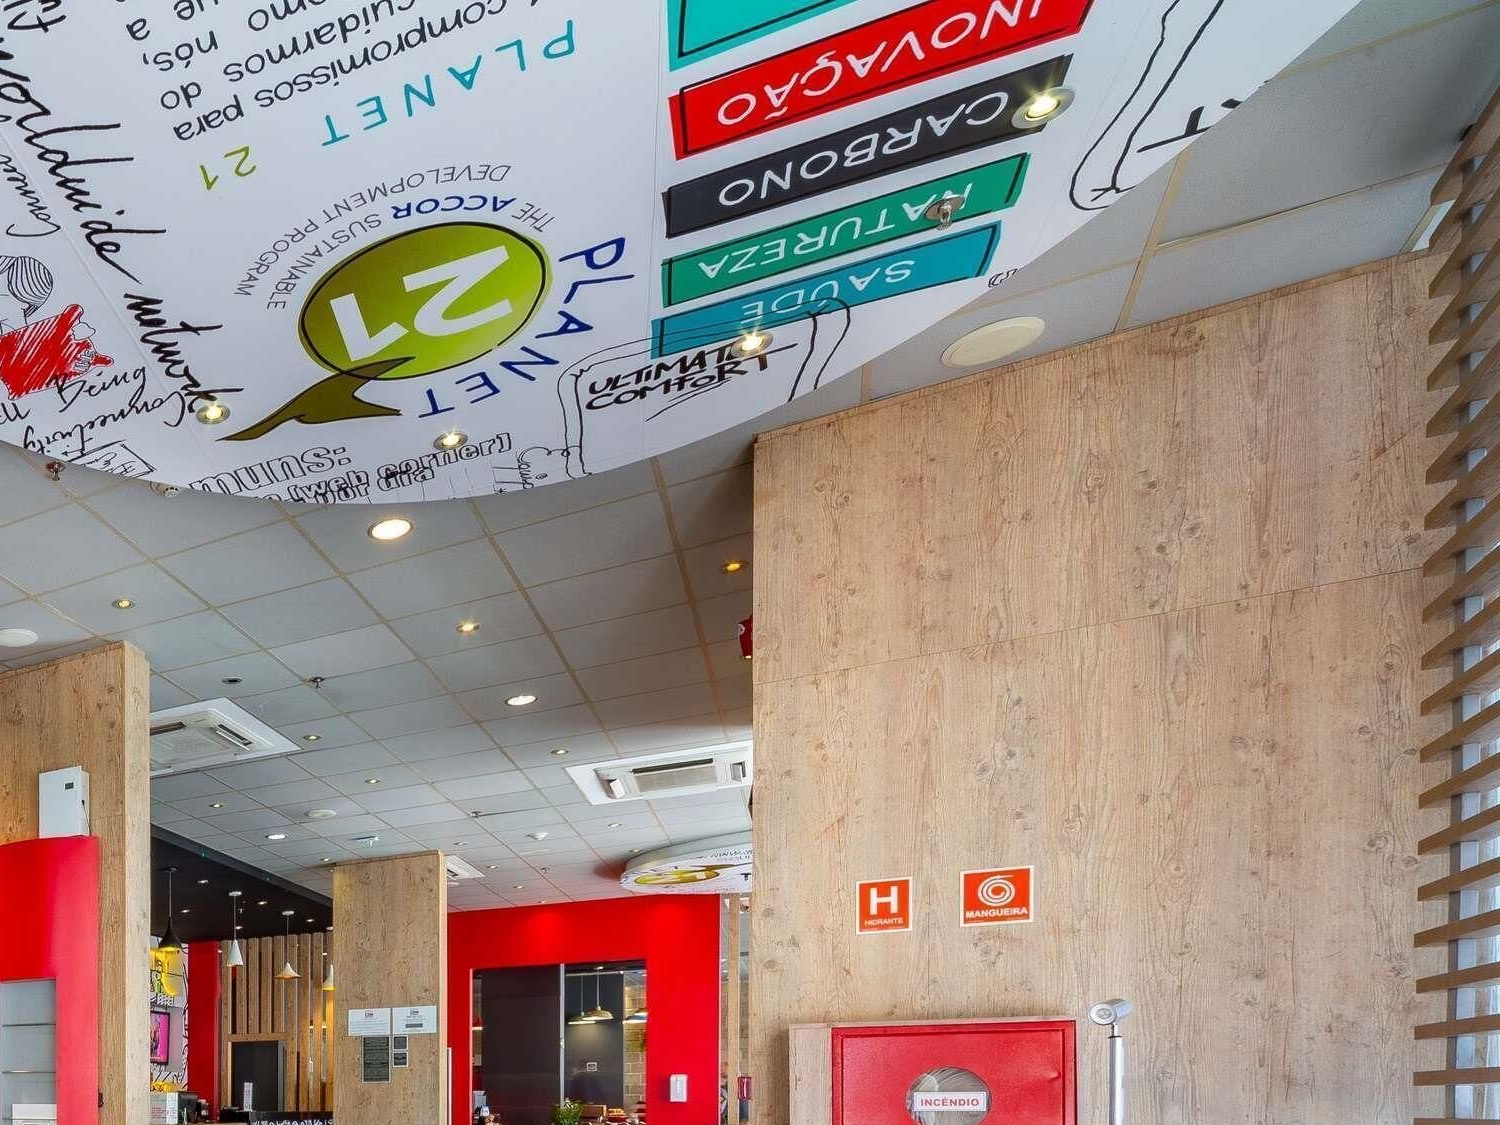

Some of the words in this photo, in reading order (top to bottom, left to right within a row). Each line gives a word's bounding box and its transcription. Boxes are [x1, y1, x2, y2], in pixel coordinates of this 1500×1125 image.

[126, 18, 150, 41] a
[142, 30, 218, 71] nós,
[321, 19, 577, 147] PLANET
[716, 0, 1043, 126] INOVAÇÃO
[160, 80, 202, 110] do
[173, 94, 245, 141] para
[200, 145, 257, 191] 21
[717, 91, 1010, 207] CARBONO
[323, 164, 512, 222] DEVELOPMENT
[392, 194, 517, 220] ACCOR
[512, 202, 556, 233] THE
[233, 213, 323, 297] PROGRAM
[698, 182, 973, 280] NATUREZA
[266, 213, 381, 310] SUSTAINABLE
[330, 245, 515, 362] 21
[741, 260, 917, 324] SAÚDE
[123, 293, 244, 414] network
[418, 236, 635, 419] PLANET
[586, 343, 798, 410] COMFORT
[864, 916, 904, 926] HIDRANTE
[869, 885, 899, 915] H
[965, 907, 1028, 919] MANGUEIRA
[920, 1096, 980, 1107] INCÊNDIO
